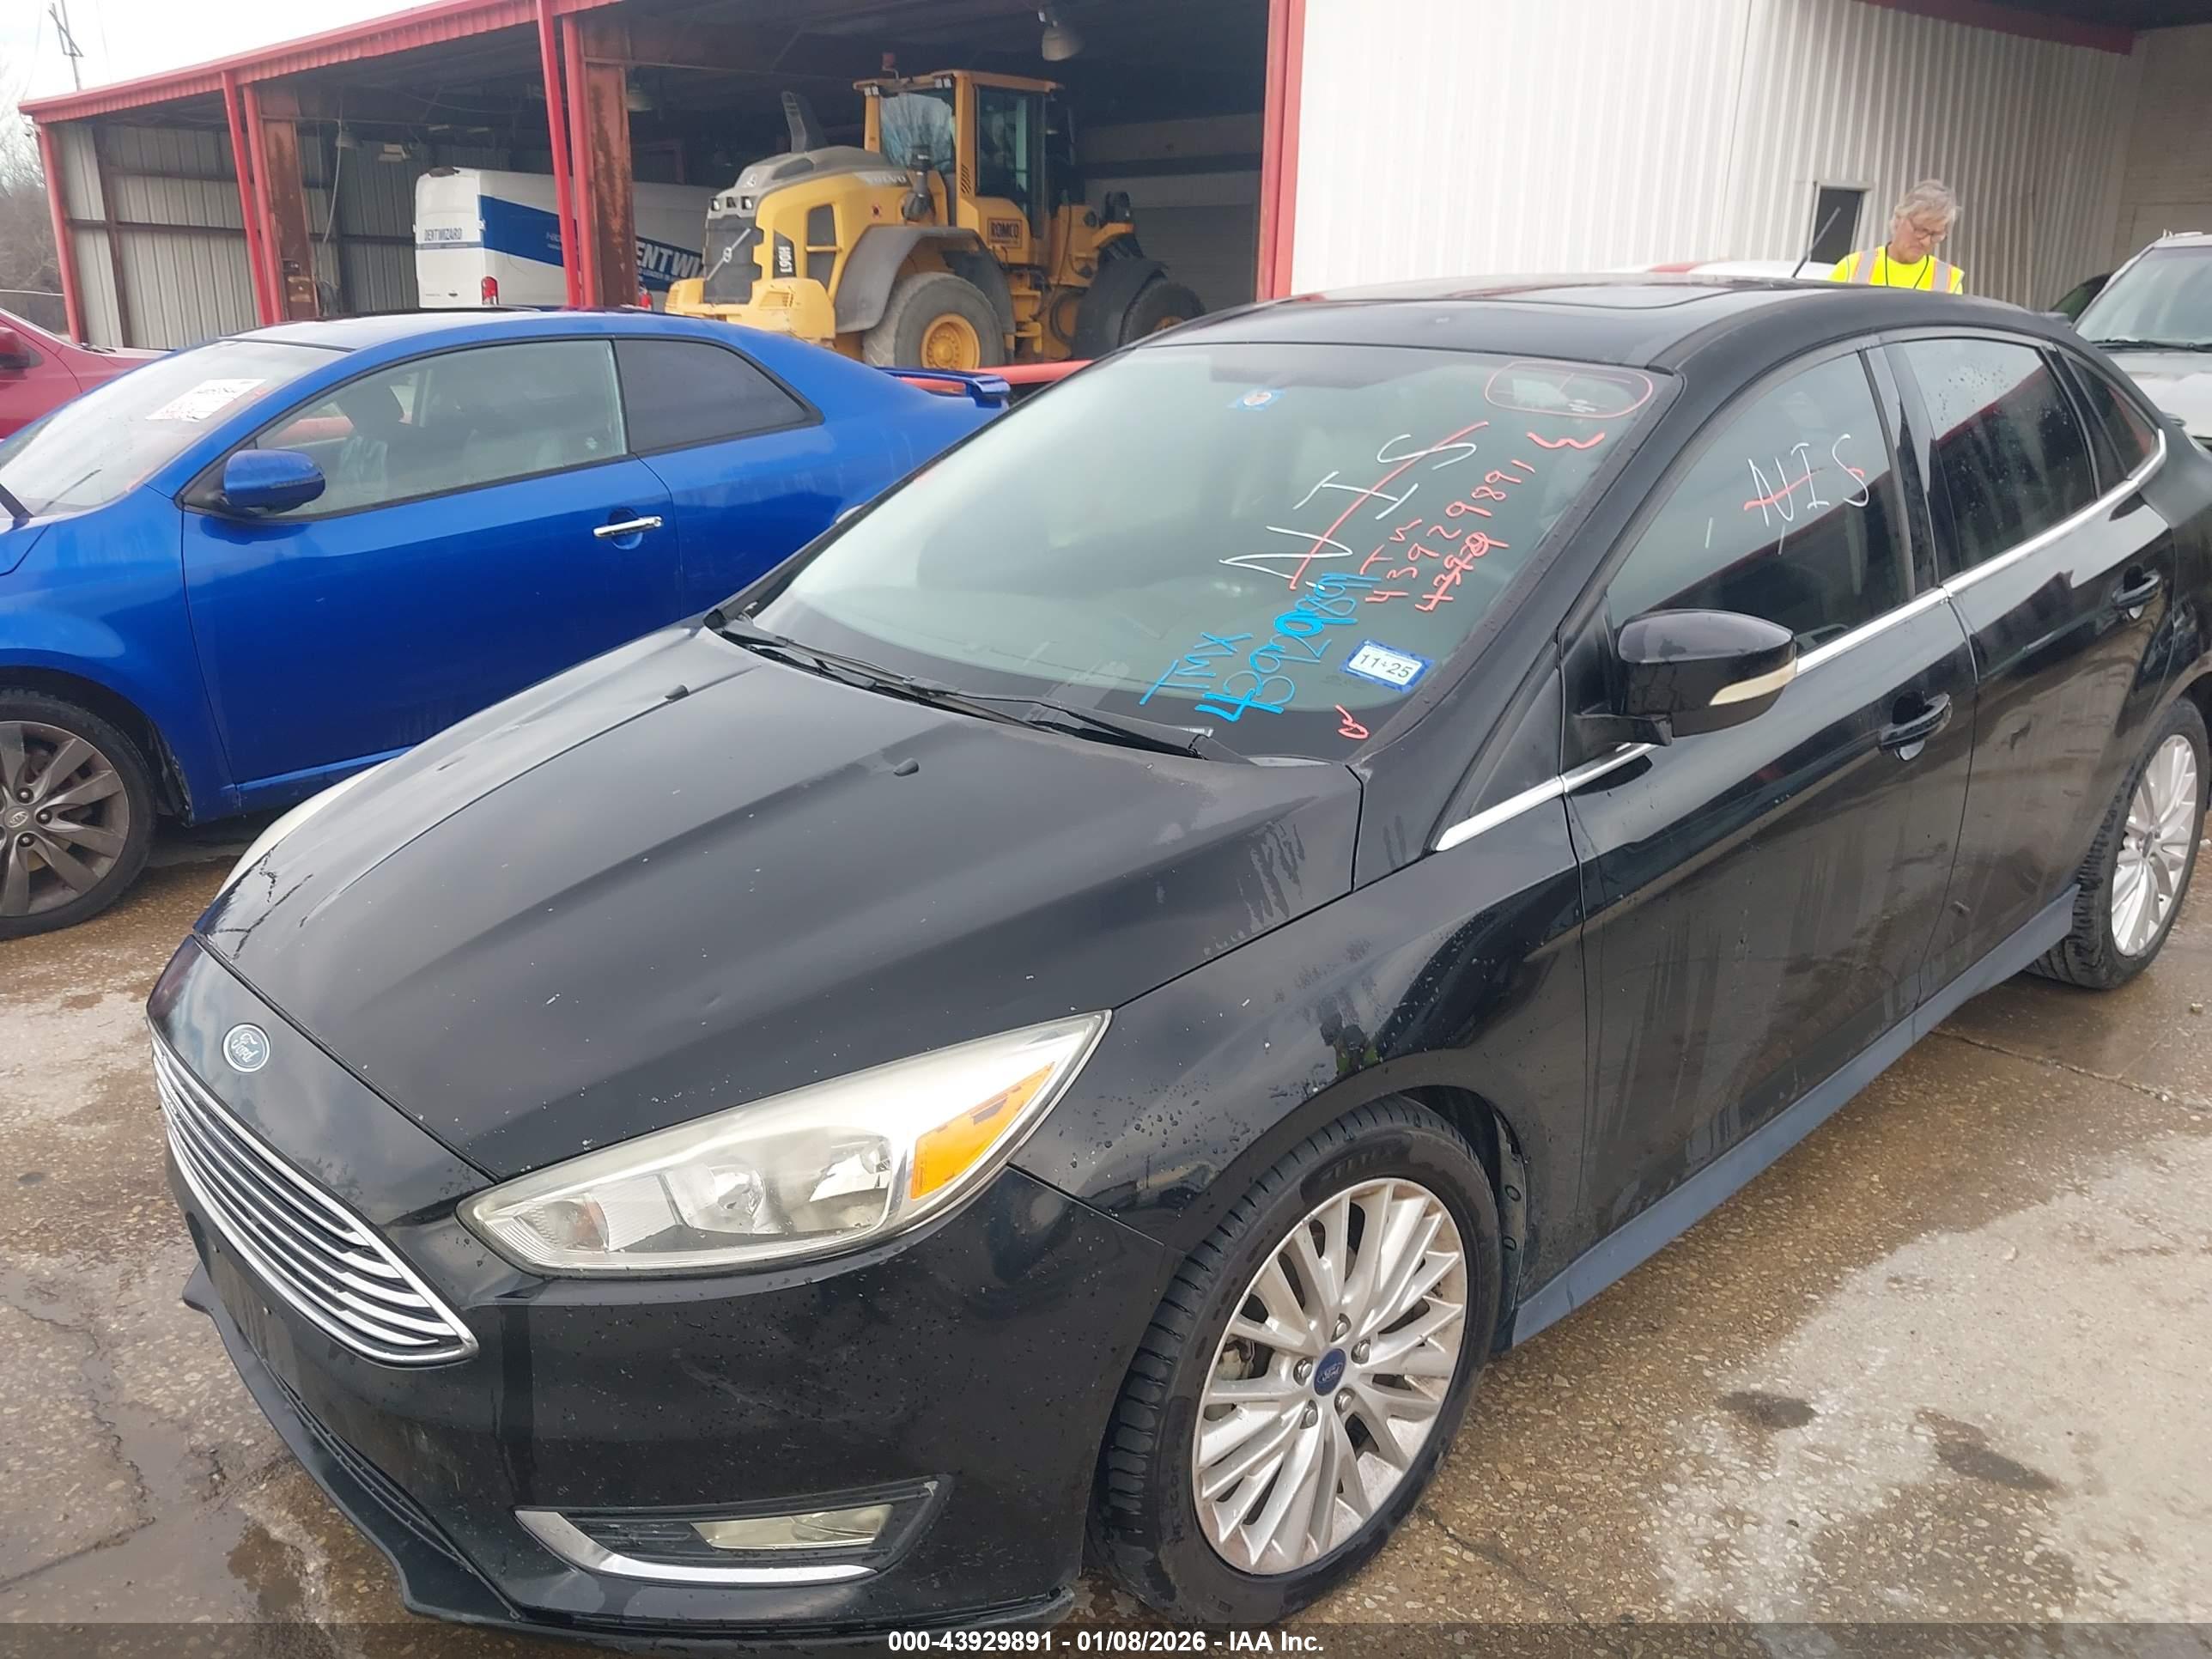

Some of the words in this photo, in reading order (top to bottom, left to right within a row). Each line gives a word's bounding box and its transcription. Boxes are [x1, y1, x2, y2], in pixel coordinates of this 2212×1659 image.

[635, 240, 703, 279] ENTWI
[777, 246, 793, 273] L90H
[1747, 433, 1869, 527] NIS
[1364, 457, 1535, 603] 43929891
[1139, 630, 1253, 706] TMX
[231, 1032, 259, 1063] Ford
